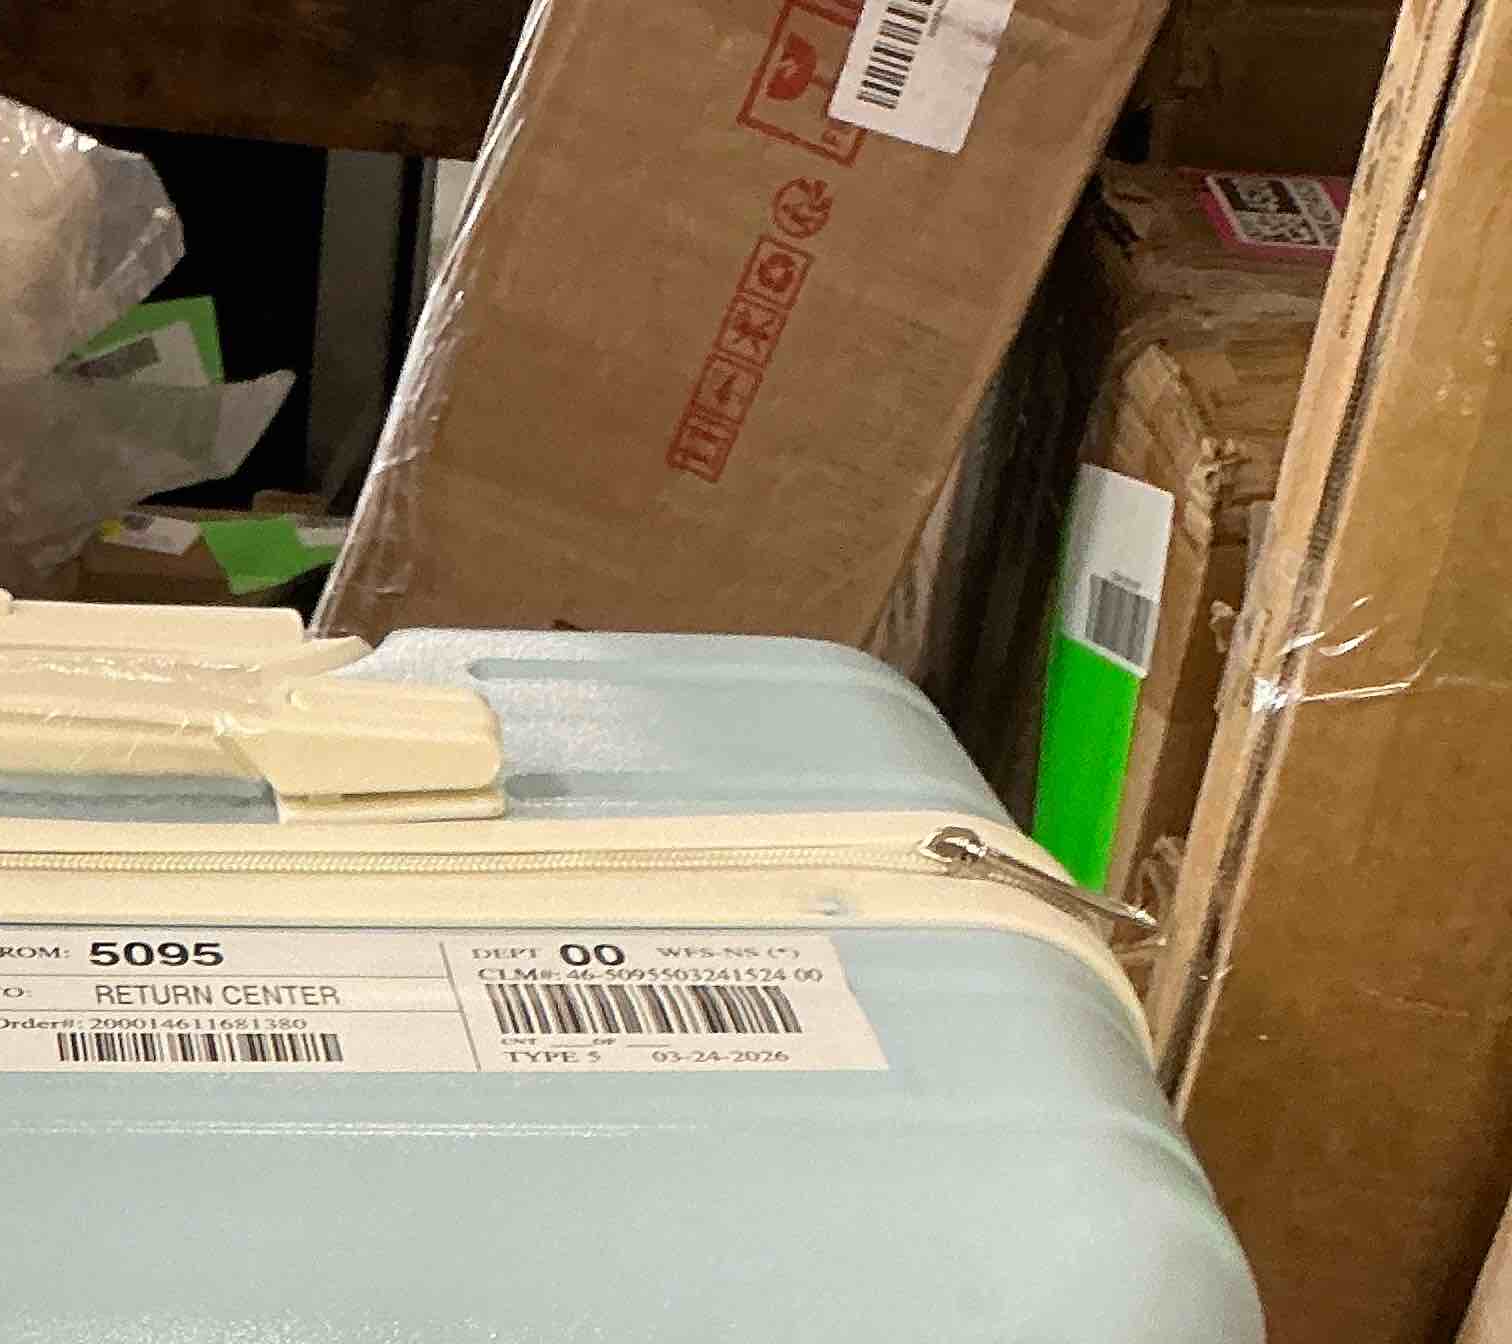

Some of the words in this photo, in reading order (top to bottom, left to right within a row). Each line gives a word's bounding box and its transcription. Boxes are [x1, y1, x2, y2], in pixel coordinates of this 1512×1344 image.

[89, 941, 225, 967] 5095
[472, 946, 542, 961] DEPT
[559, 943, 625, 967] 00
[95, 985, 212, 1006] RETURN
[222, 985, 341, 1006] CENTER
[504, 1050, 580, 1064] TYPE
[588, 1050, 601, 1064] 5
[651, 1049, 790, 1064] 03-24-2026
